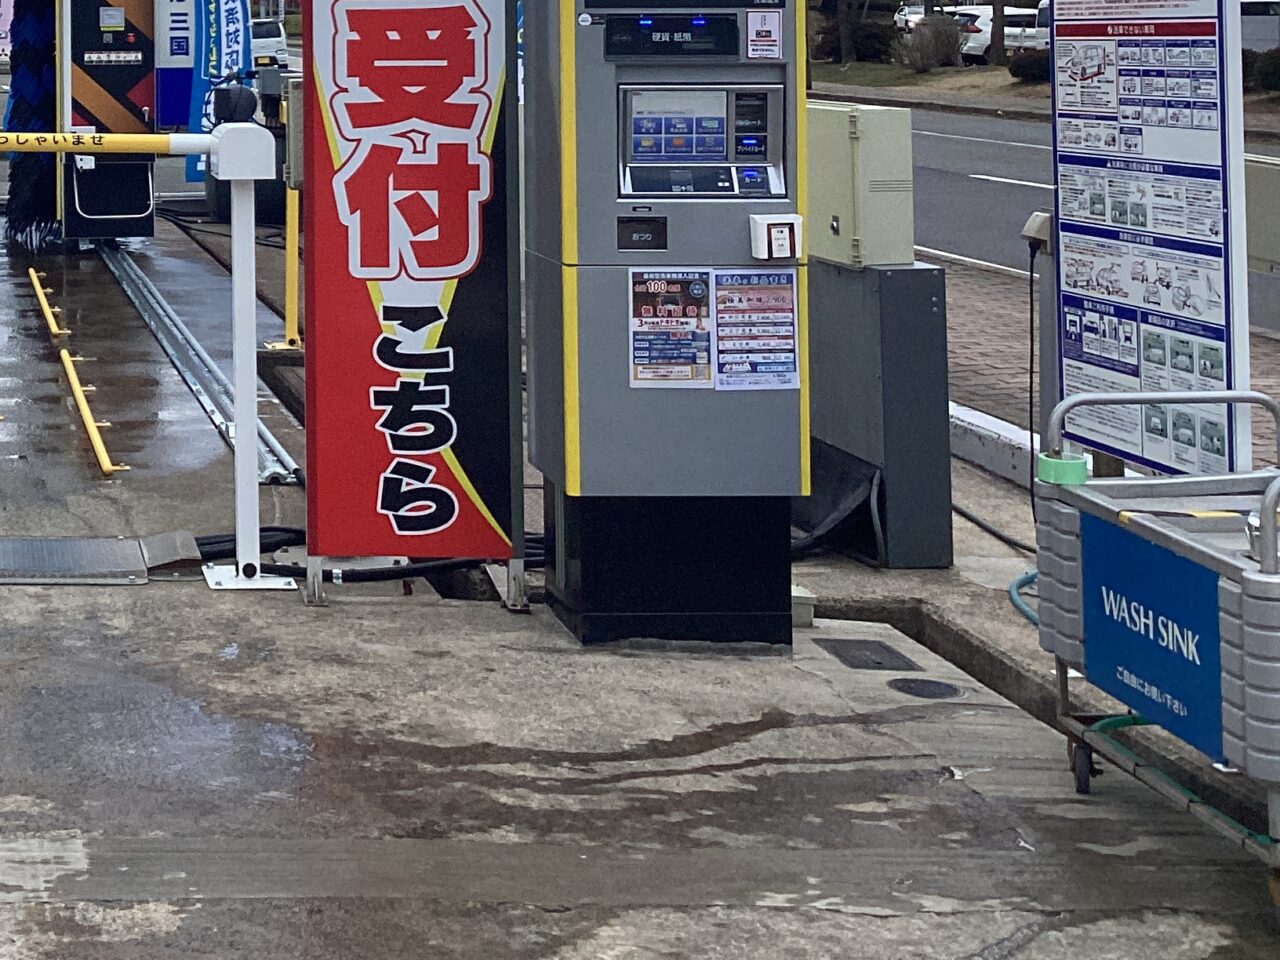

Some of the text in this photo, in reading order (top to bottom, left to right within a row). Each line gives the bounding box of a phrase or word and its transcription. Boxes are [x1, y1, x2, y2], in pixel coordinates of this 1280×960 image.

[338, 0, 485, 273] 受付
[371, 303, 458, 535] こちら
[1101, 586, 1200, 666] WASH SINK
